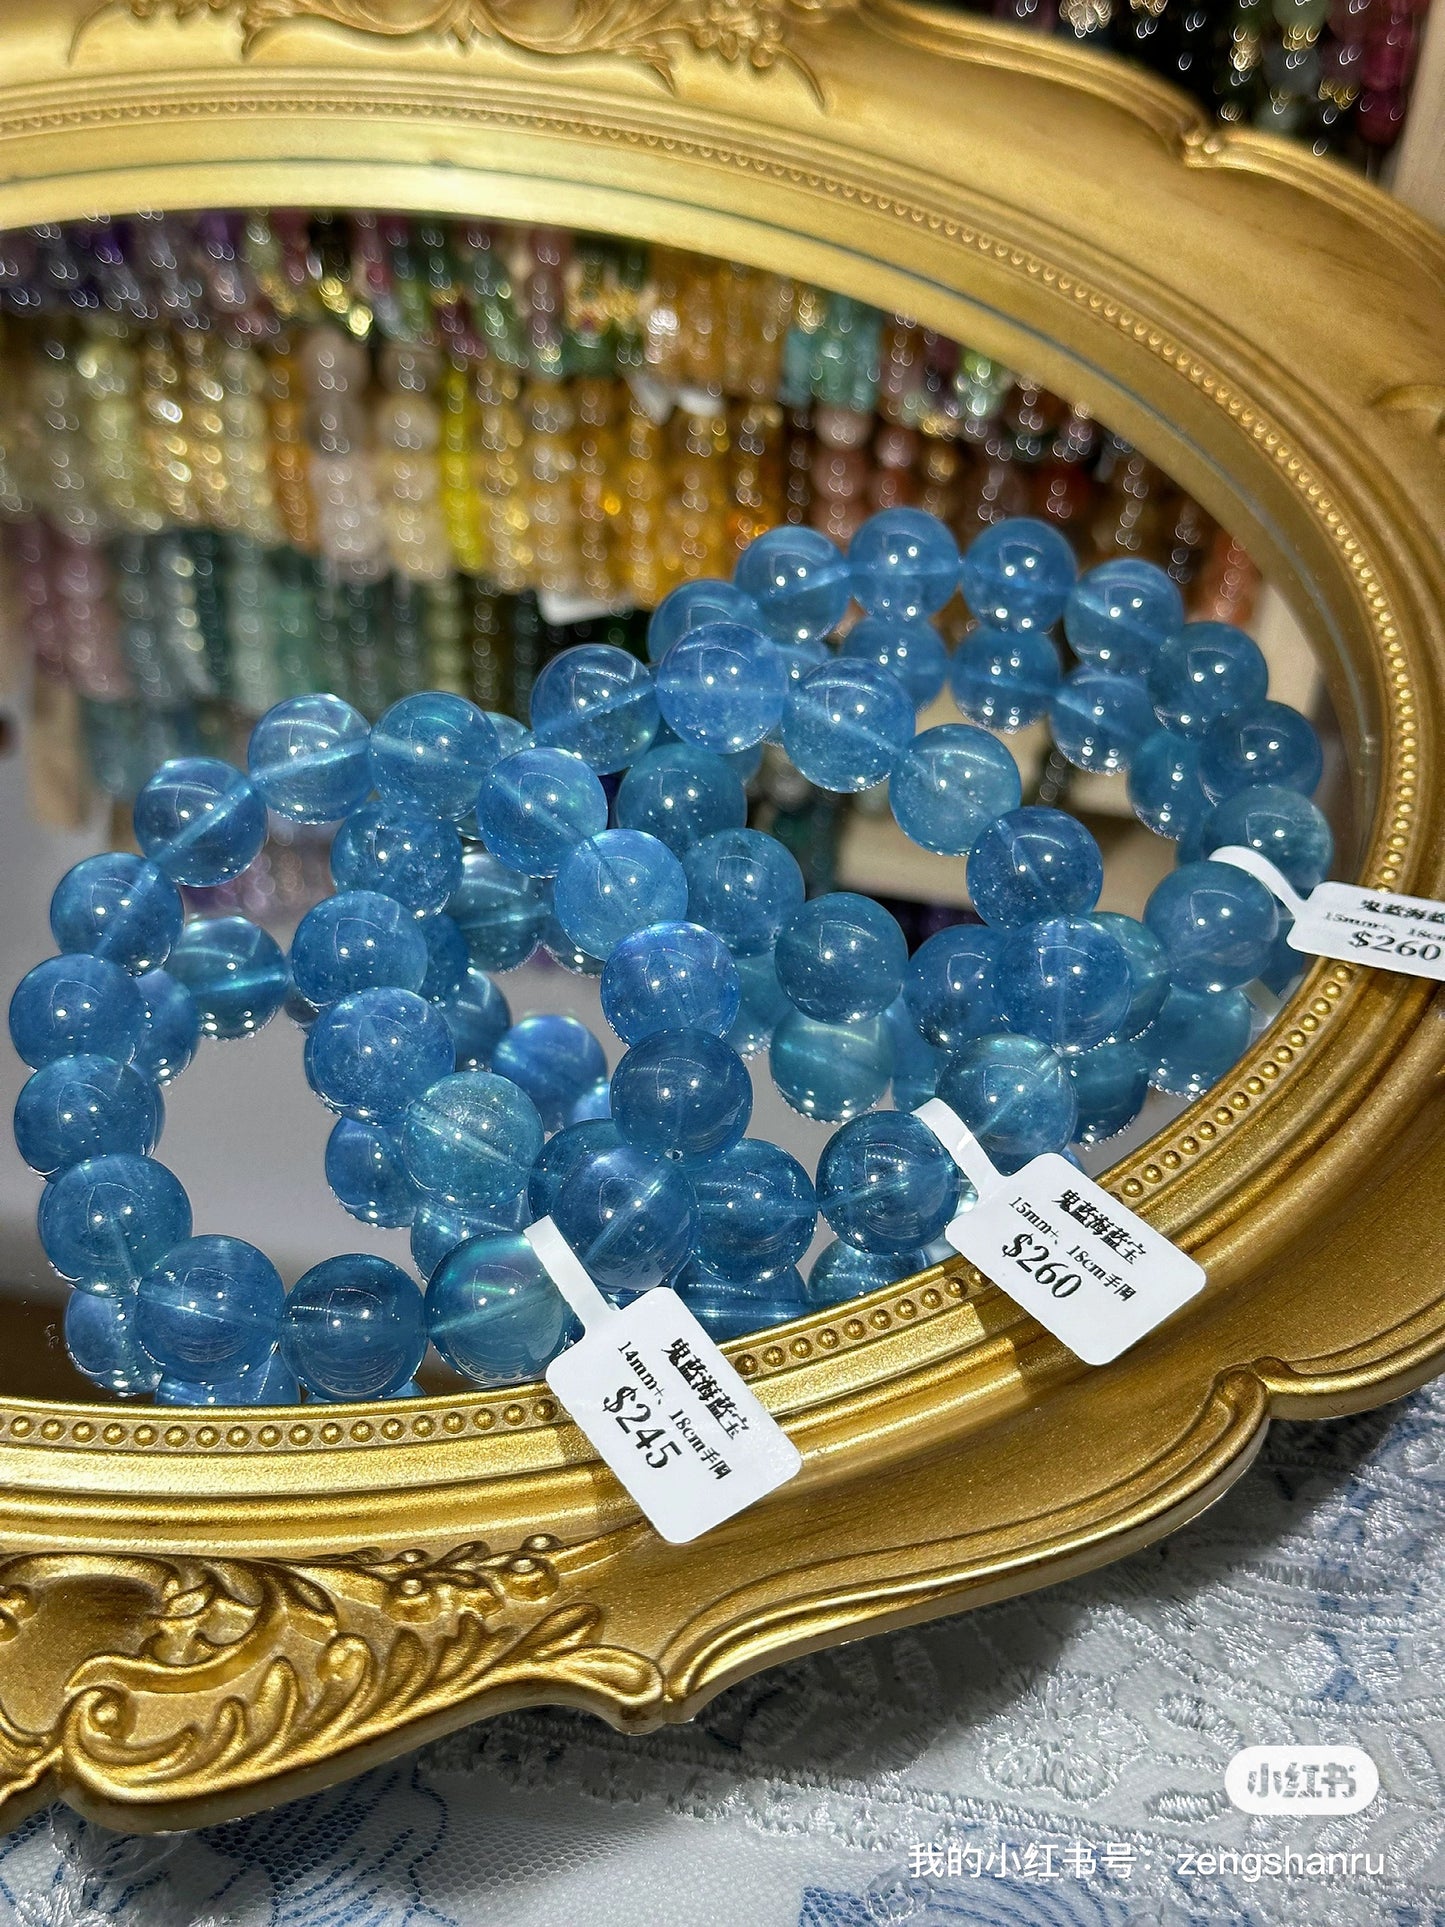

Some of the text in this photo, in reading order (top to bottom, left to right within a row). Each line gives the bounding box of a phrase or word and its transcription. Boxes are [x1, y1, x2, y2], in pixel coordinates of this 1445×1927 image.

[1348, 930, 1442, 961] $260
[1001, 1231, 1082, 1299] $260
[1052, 1189, 1147, 1265] 鬼蓝海蓝宝
[602, 1385, 682, 1469] $245
[660, 1337, 750, 1441] 鬼蓝海蓝宝
